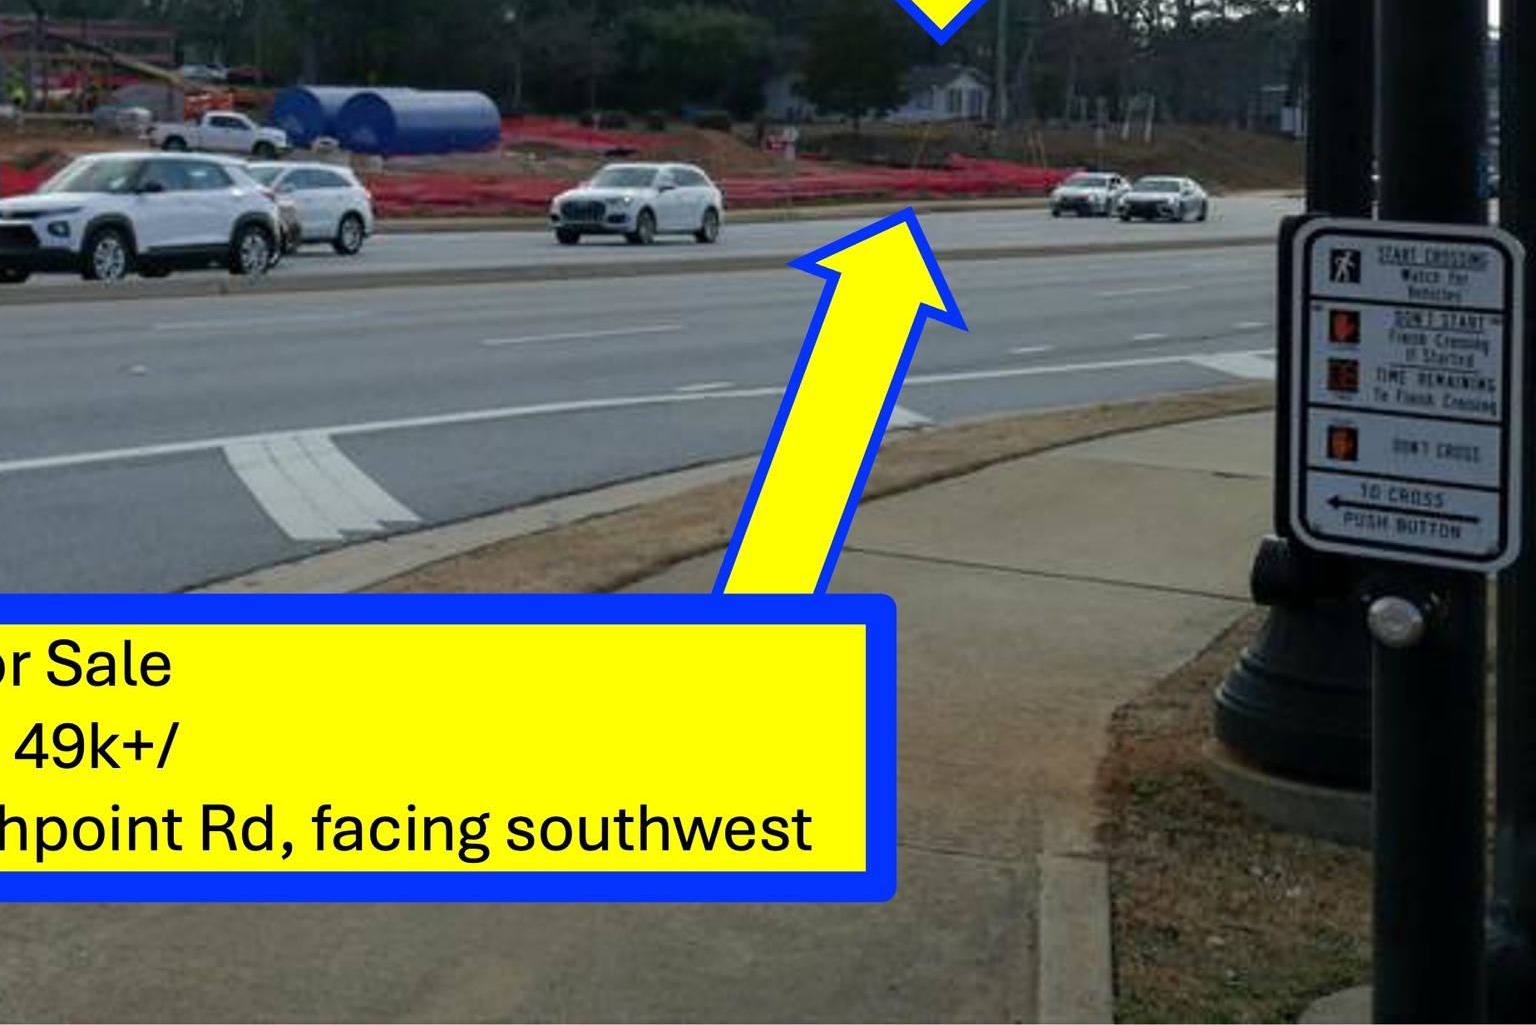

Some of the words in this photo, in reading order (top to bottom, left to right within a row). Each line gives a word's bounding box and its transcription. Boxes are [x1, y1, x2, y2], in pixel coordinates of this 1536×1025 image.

[1359, 482, 1381, 500] TO
[1388, 485, 1445, 508] CROSS
[1343, 511, 1389, 531] PUSH
[1396, 517, 1461, 538] BUTTON
